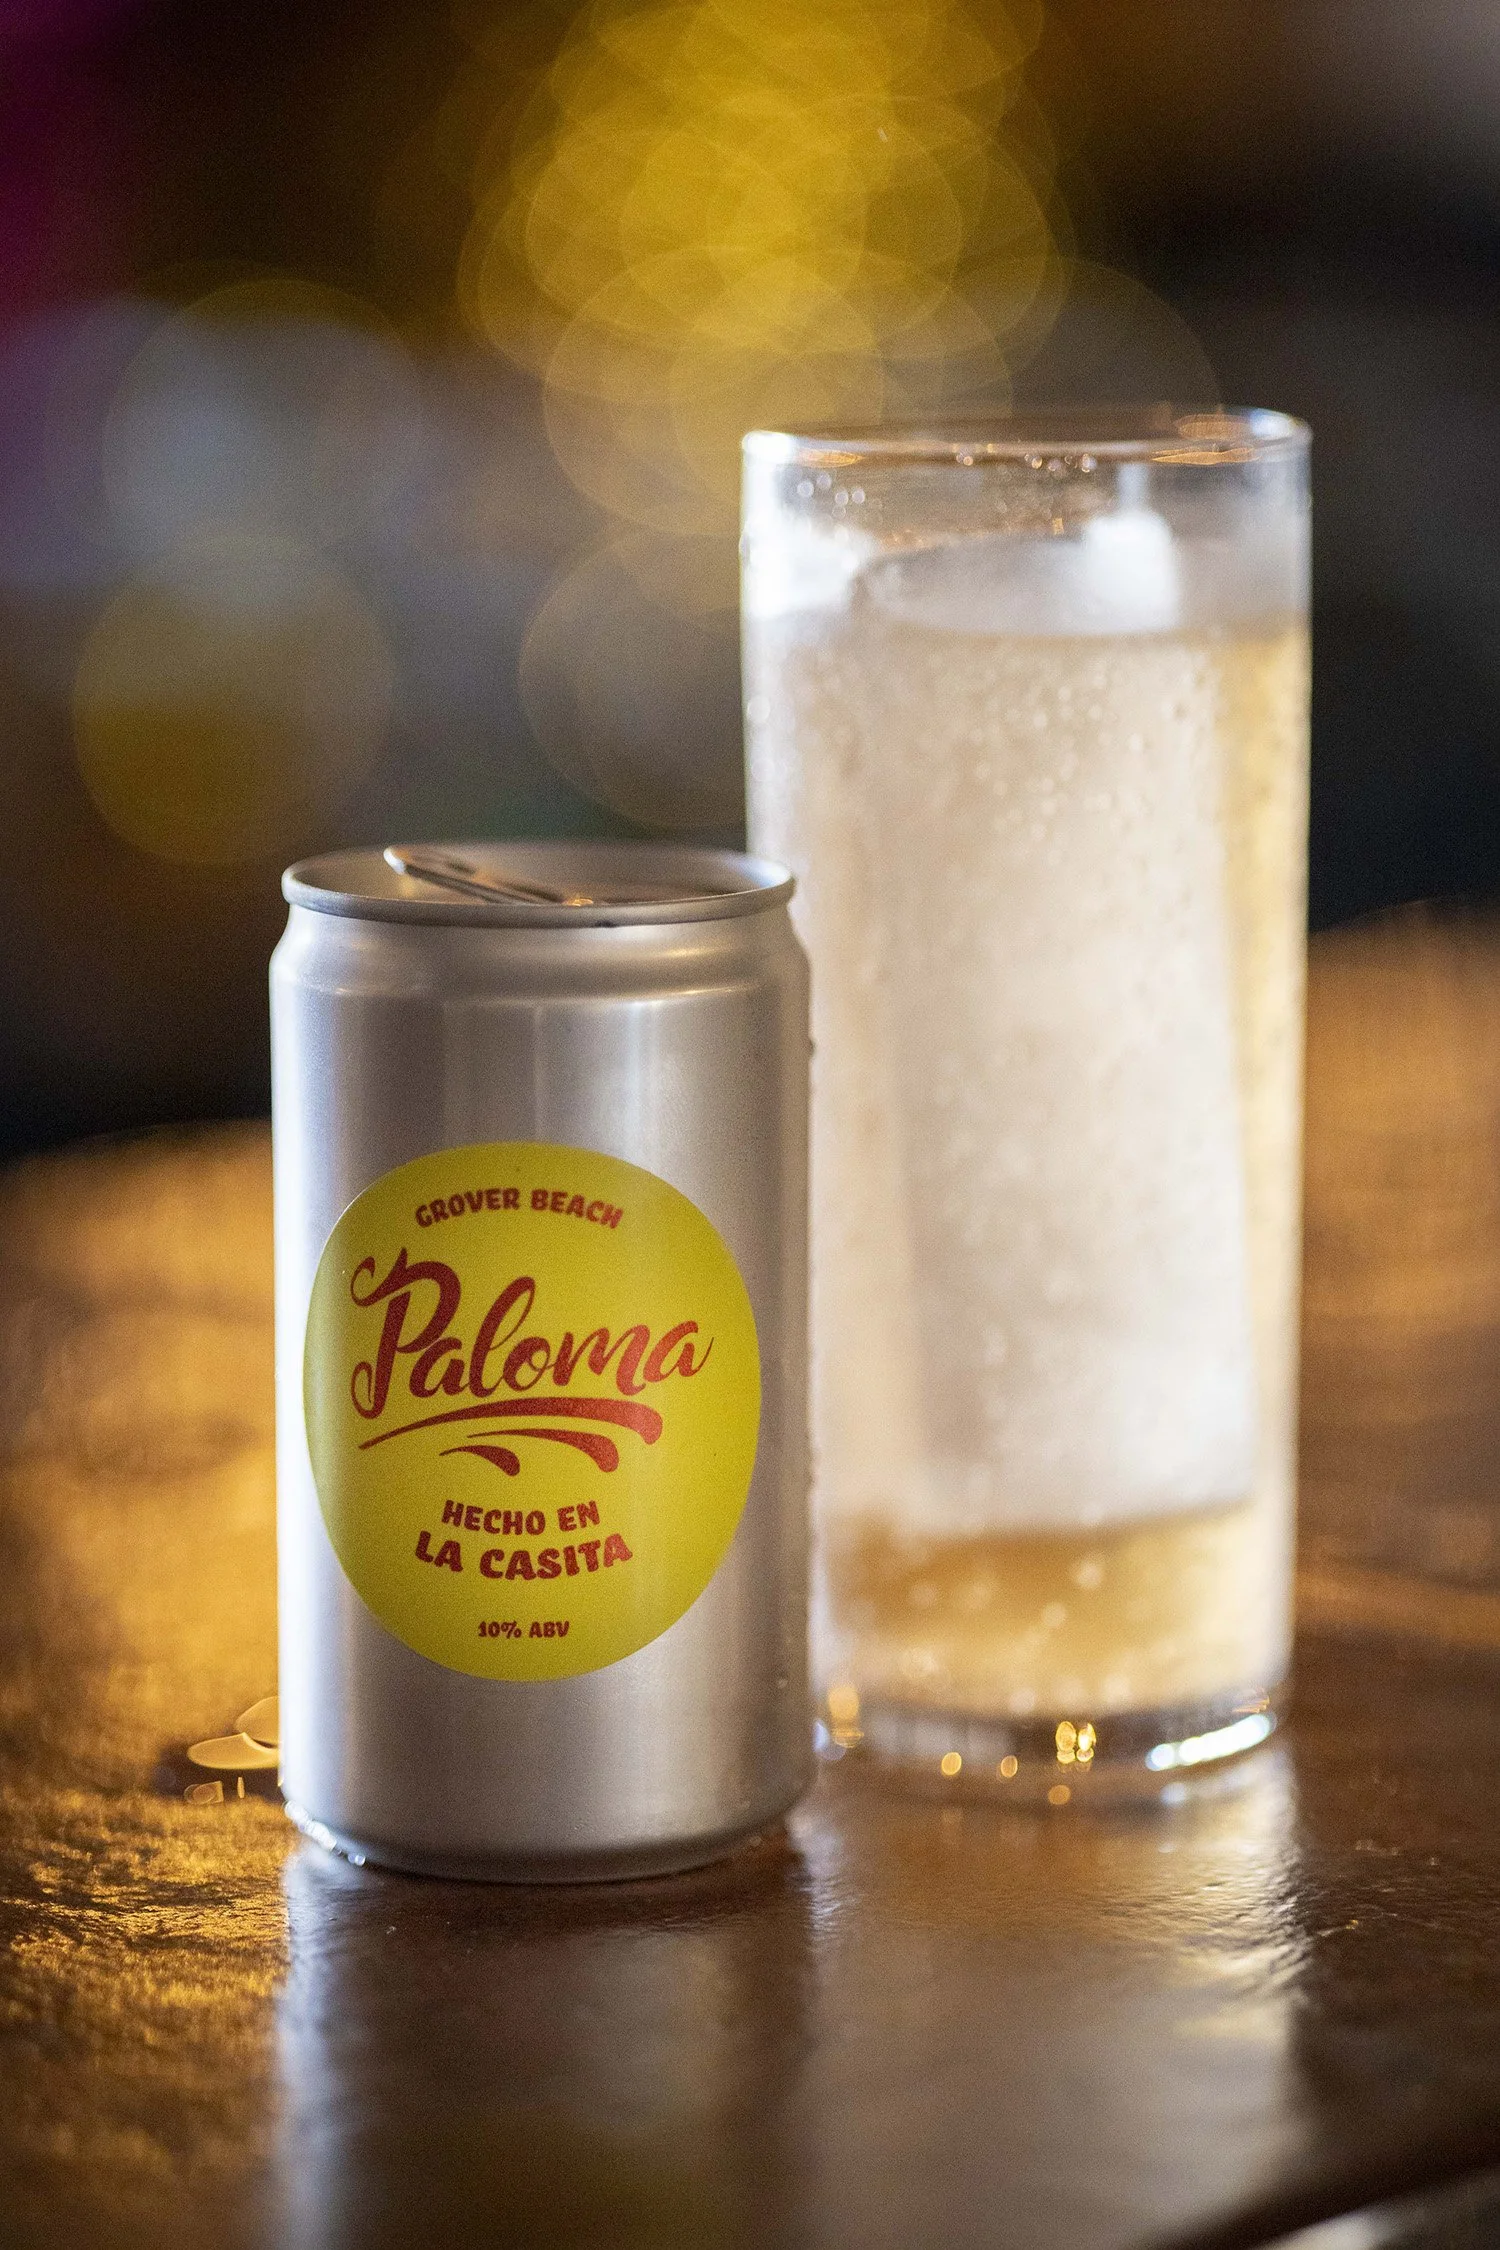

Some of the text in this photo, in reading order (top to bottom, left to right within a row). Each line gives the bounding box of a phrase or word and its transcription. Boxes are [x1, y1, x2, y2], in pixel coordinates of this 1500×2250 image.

[415, 1187, 623, 1229] GROVER BEACH
[350, 1247, 713, 1418] Paloma
[440, 1499, 600, 1535] HECHO EN
[415, 1529, 633, 1581] LA CASITA
[477, 1619, 570, 1639] 10% ABV
